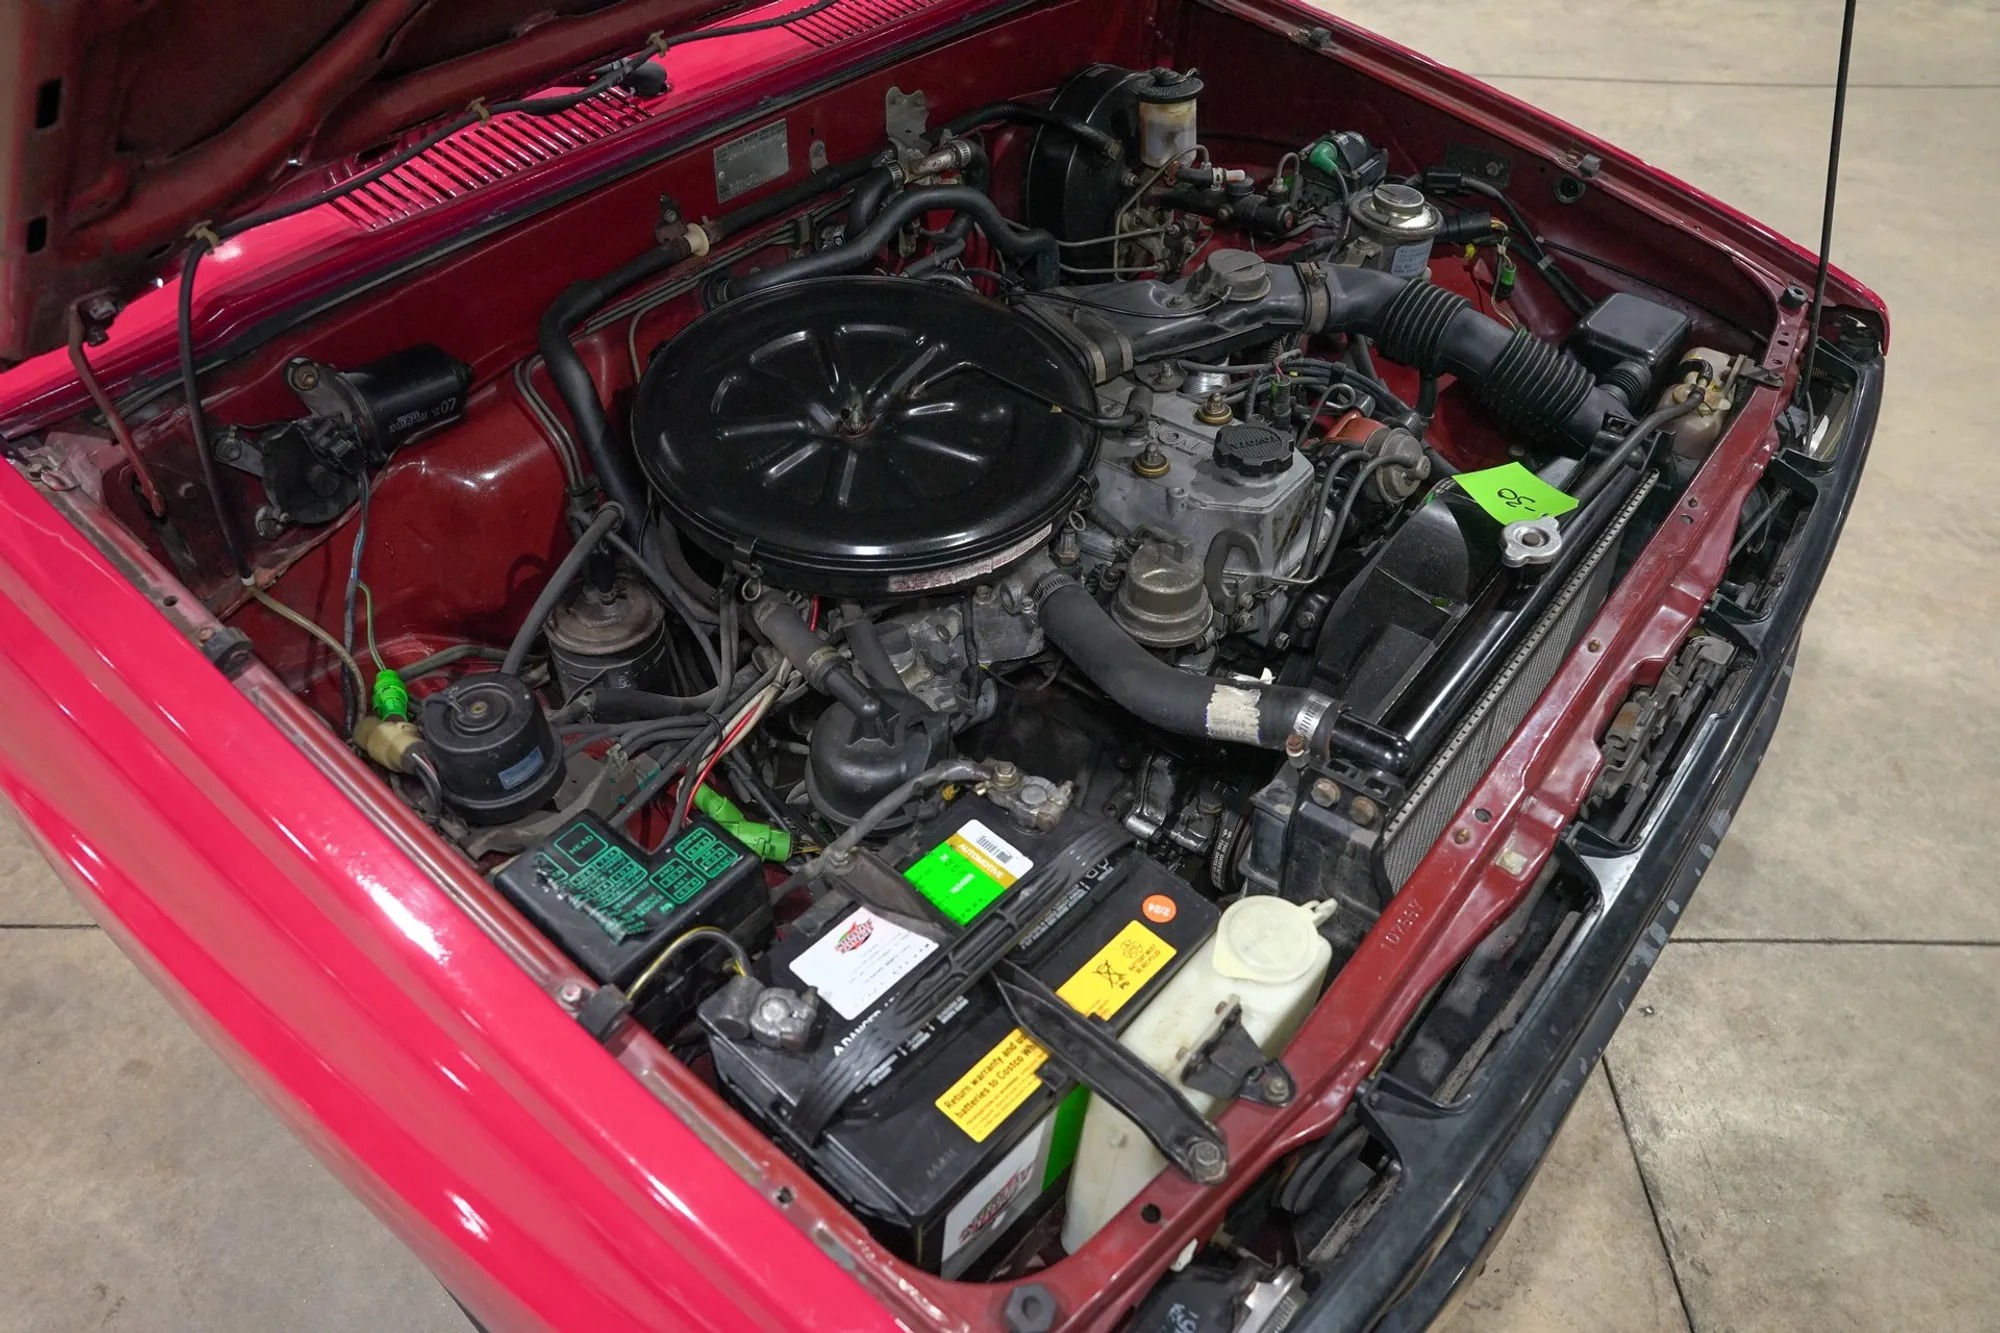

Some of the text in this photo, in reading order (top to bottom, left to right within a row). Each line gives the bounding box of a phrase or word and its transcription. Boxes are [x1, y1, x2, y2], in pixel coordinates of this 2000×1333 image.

[568, 834, 594, 855] HEAD
[958, 843, 1004, 879] AUTOMOTIVE
[835, 919, 873, 951] INTERSTATE
[841, 926, 874, 954] BATTERIES
[944, 1085, 972, 1109] Return
[971, 1056, 1003, 1087] warranty
[1002, 1041, 1017, 1057] and
[954, 1087, 990, 1119] batteries
[988, 1079, 999, 1088] to
[996, 1056, 1024, 1080] Costco
